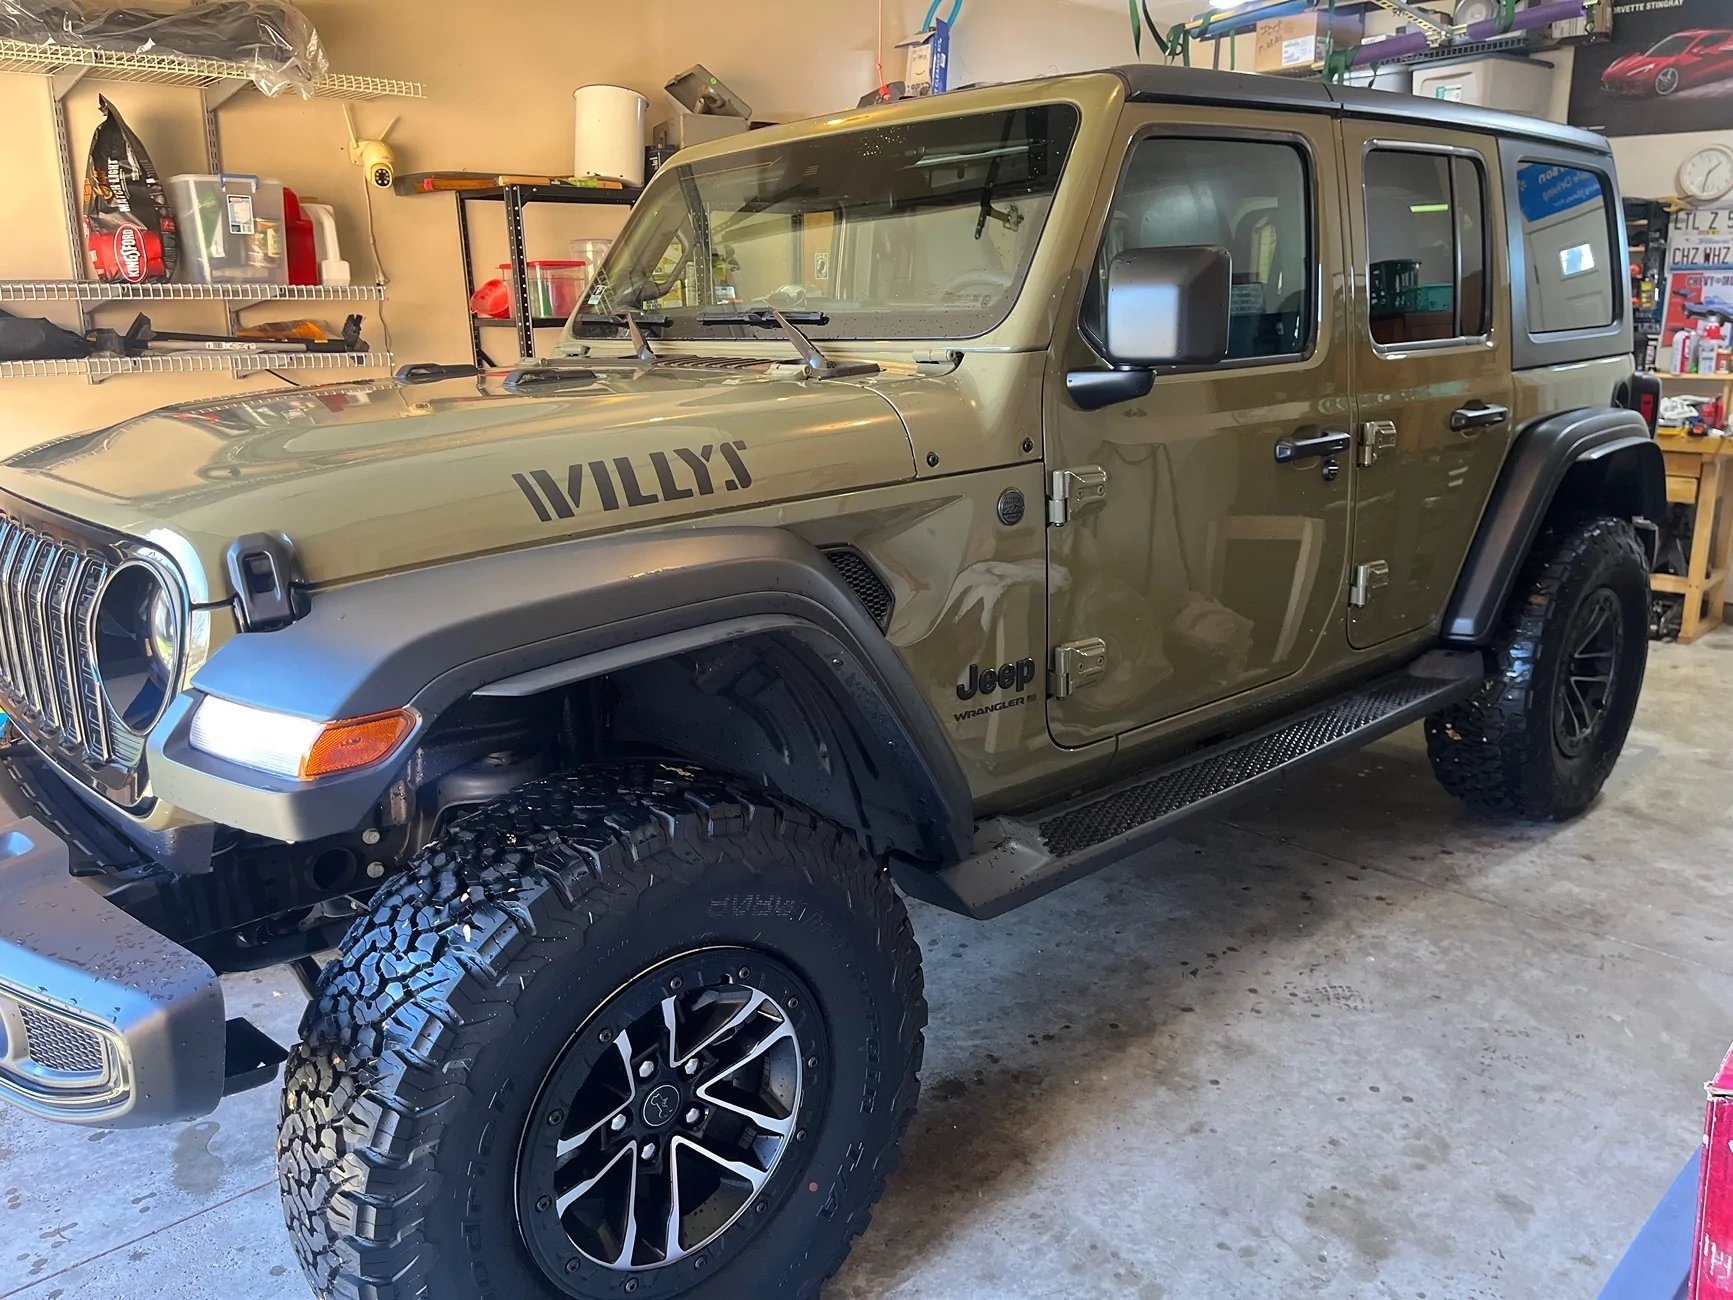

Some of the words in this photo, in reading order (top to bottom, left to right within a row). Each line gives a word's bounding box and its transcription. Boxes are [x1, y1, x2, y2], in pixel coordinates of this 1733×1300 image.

[107, 156, 120, 183] LIGHT
[110, 184, 131, 212] MATCH
[1709, 211, 1719, 229] Z
[119, 229, 140, 278] KINGSFORD
[1672, 247, 1700, 265] CHZ
[1703, 246, 1731, 265] WHZ
[511, 440, 753, 522] WILLYS
[956, 657, 1036, 701] Jeep
[953, 697, 1025, 722] WRANGLER
